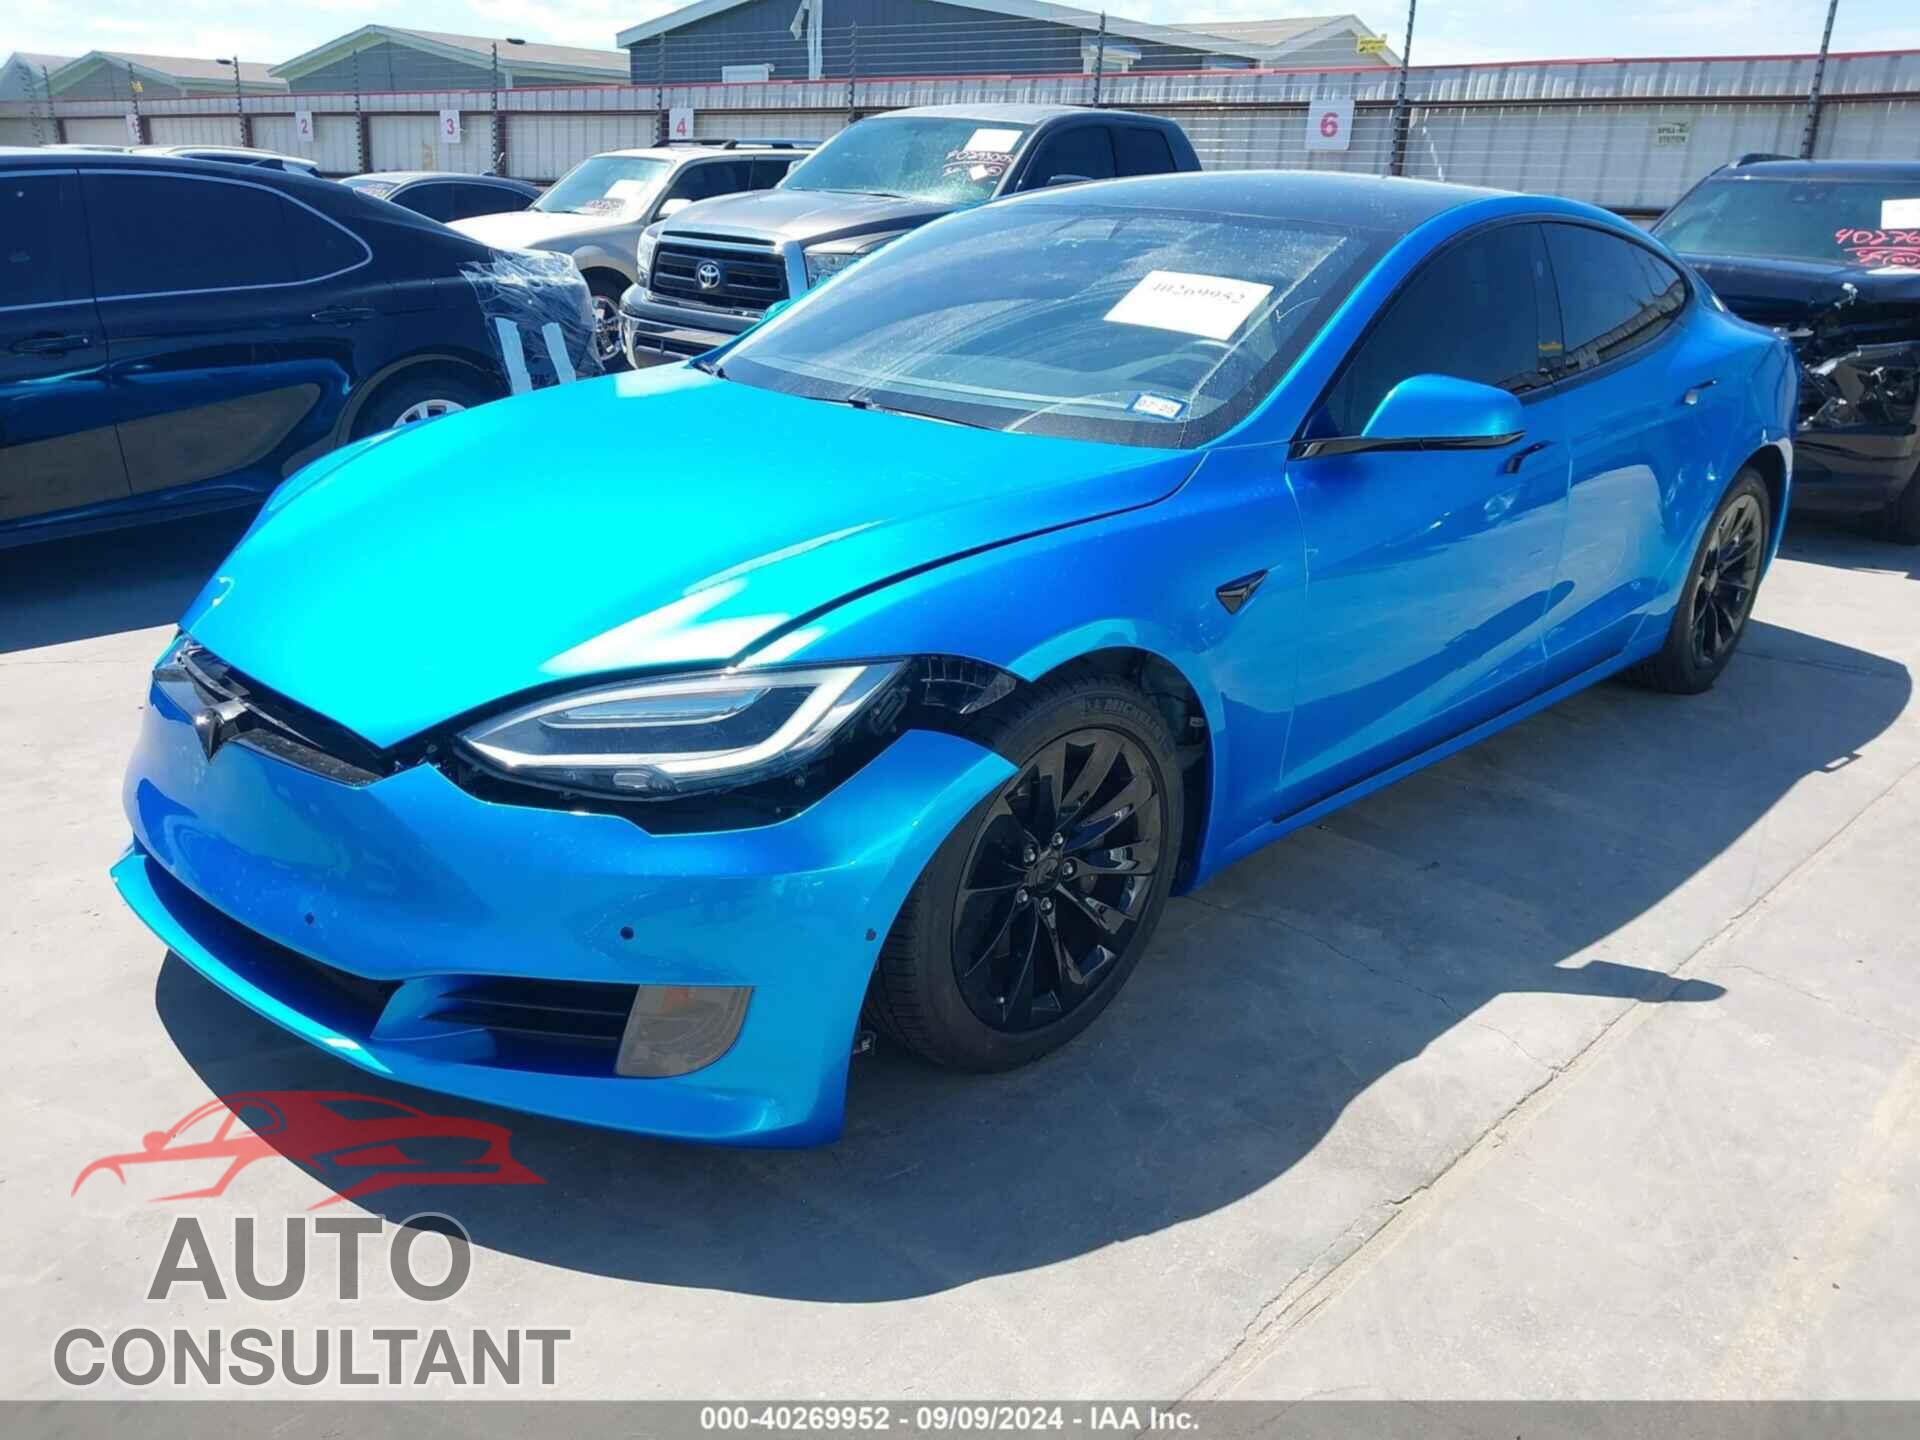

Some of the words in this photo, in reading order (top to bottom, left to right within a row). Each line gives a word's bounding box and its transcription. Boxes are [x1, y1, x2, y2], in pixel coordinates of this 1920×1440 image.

[300, 118, 309, 134] 2
[446, 118, 455, 135] 3
[676, 118, 687, 136] 4
[1320, 111, 1338, 138] 6
